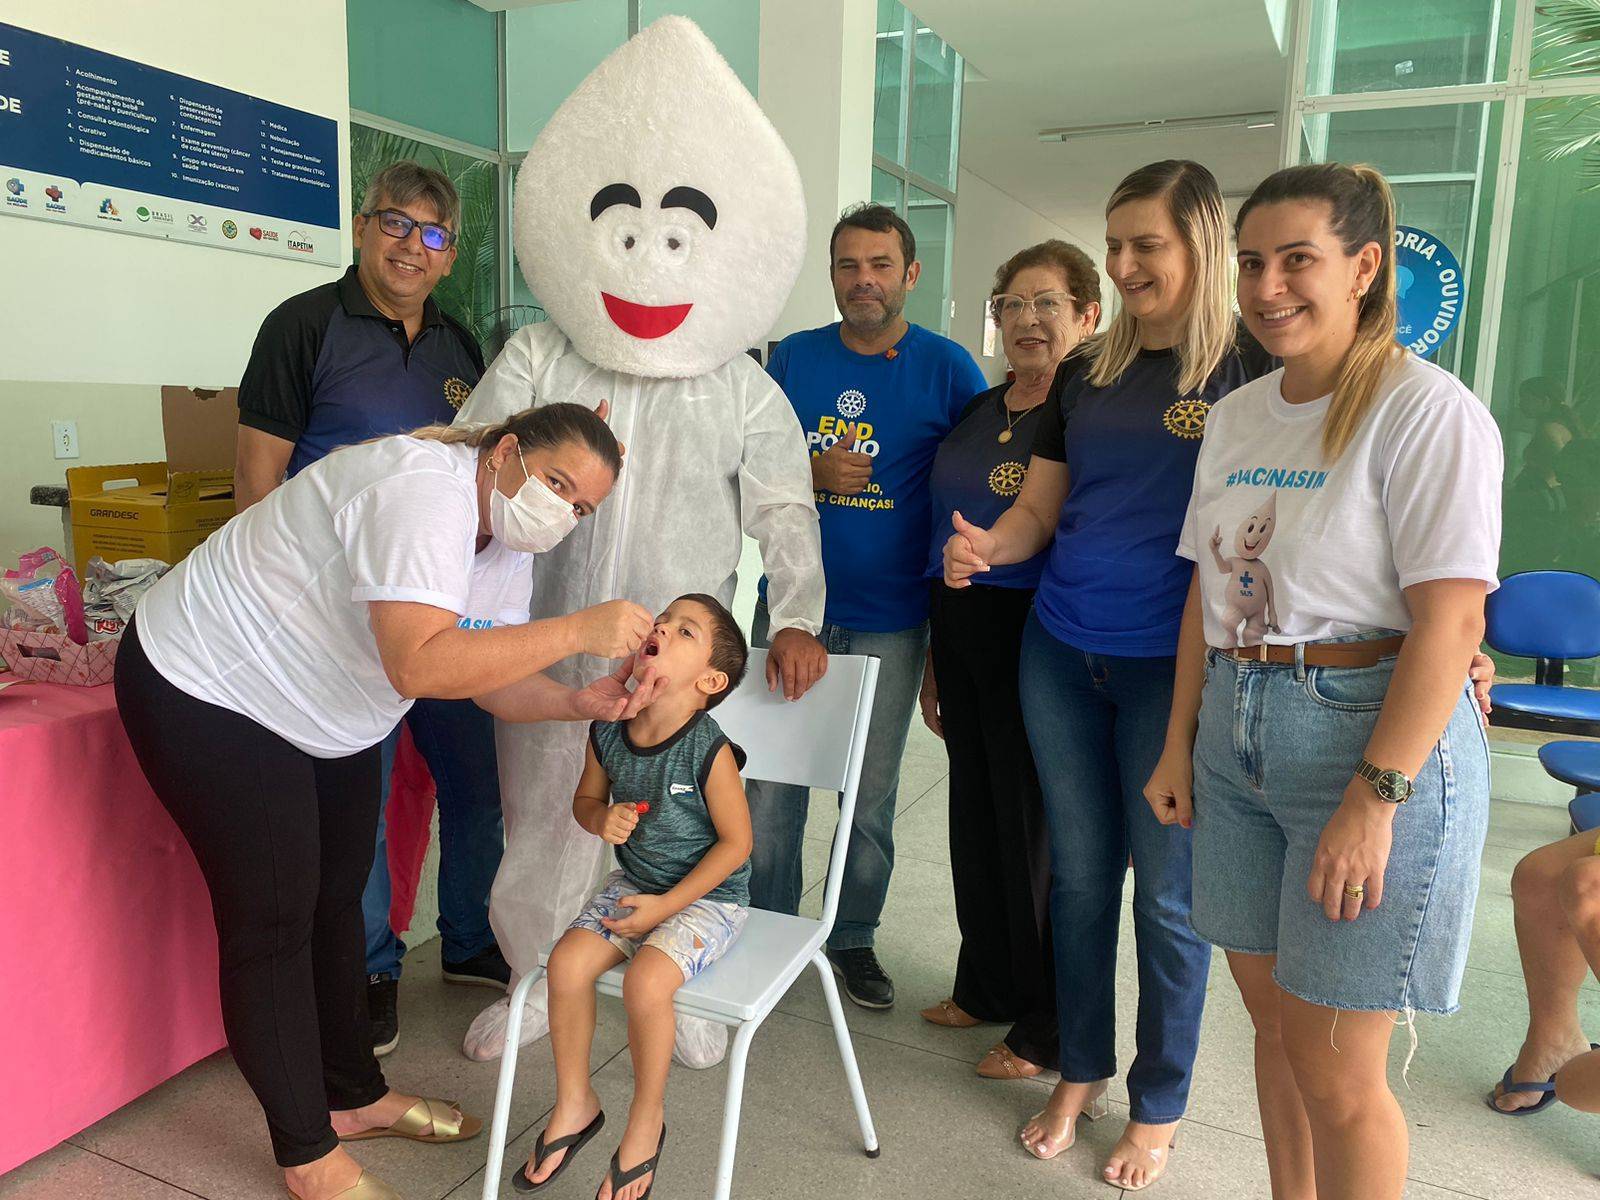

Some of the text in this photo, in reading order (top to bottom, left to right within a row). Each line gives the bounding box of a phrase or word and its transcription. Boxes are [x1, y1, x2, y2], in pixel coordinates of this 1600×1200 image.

[76, 69, 118, 85] Acolhimento
[76, 83, 135, 104] Acompanhamento
[76, 91, 105, 102] gestante
[112, 99, 121, 107] do
[122, 101, 138, 111] bebê
[76, 97, 110, 110] (pré-natal
[117, 108, 157, 123] puericultura)
[180, 97, 214, 112] Dispensação
[180, 105, 217, 119] preservativos
[78, 111, 107, 123] Consulta
[108, 119, 150, 134] odontológica
[180, 111, 221, 126] contraceptivos
[78, 125, 107, 137] Curativo
[180, 123, 216, 137] Enfermagem
[270, 122, 287, 132] Médica
[80, 139, 120, 154] Dispensação
[181, 136, 200, 146] Exame
[201, 142, 230, 153] preventivo
[230, 148, 250, 158] (câncer
[270, 134, 300, 147] Nebulização
[80, 147, 151, 167] medicamentos básicos
[190, 145, 202, 153] colo
[211, 150, 228, 159] útero)
[270, 146, 303, 159] Planejamento
[304, 154, 322, 164] familiar
[182, 156, 200, 165] Grupo
[209, 162, 234, 173] educação
[182, 162, 199, 171] saúde
[271, 158, 284, 166] Teste
[292, 164, 312, 173] gravidez
[183, 175, 214, 187] Imunização
[215, 182, 239, 192] (vacinas)
[271, 170, 299, 181] Tratamento
[300, 177, 330, 188] odontológico
[288, 240, 313, 249] ITAPETIM
[1406, 268, 1459, 355] OUVIDOR
[806, 431, 880, 458] POIO
[829, 495, 894, 511] CRIANÇAS!
[90, 508, 139, 520] GRANDESC
